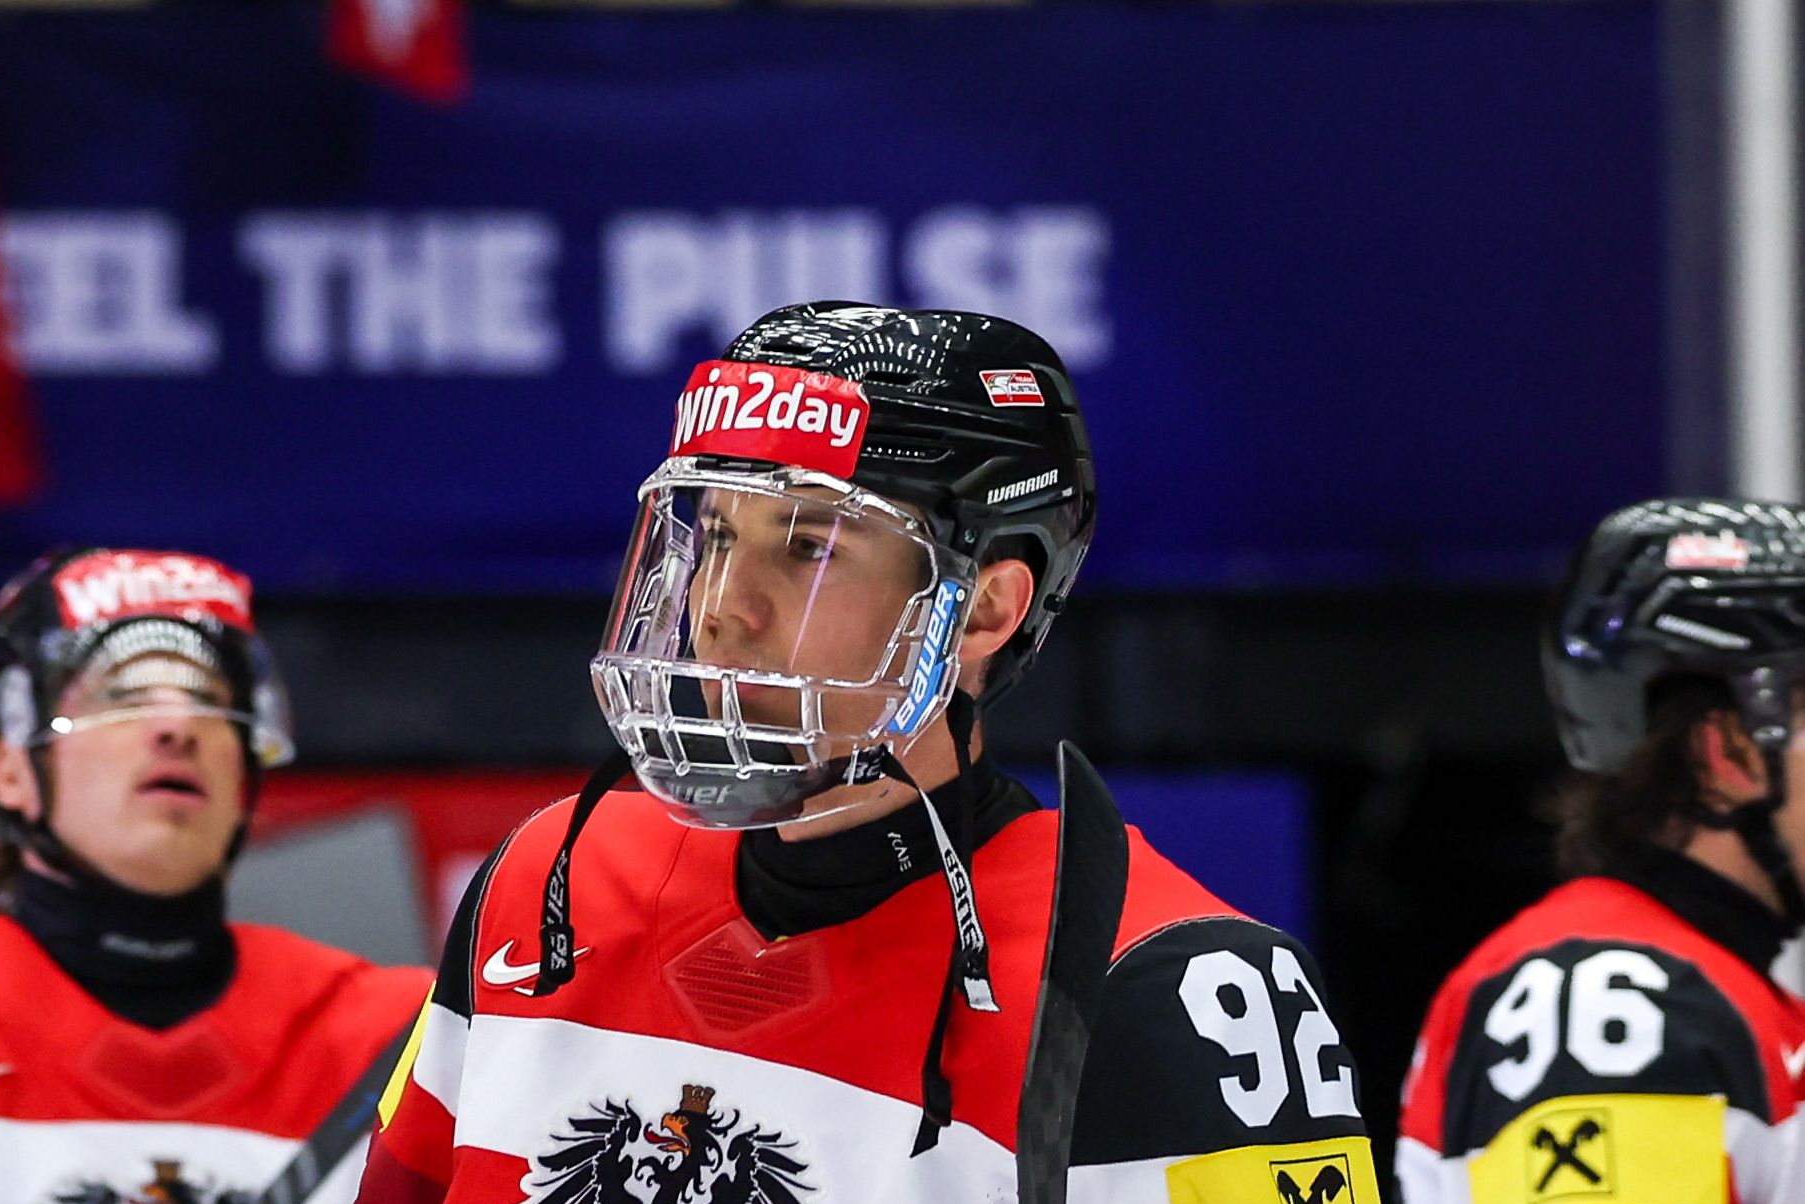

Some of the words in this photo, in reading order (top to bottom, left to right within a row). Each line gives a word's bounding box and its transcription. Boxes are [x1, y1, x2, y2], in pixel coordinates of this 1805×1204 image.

[235, 208, 563, 376] THE
[674, 367, 861, 452] win2day
[986, 467, 1059, 505] WARRIOR
[894, 582, 953, 731] BAUER
[1178, 946, 1362, 1127] 92
[1484, 949, 1669, 1101] 96
